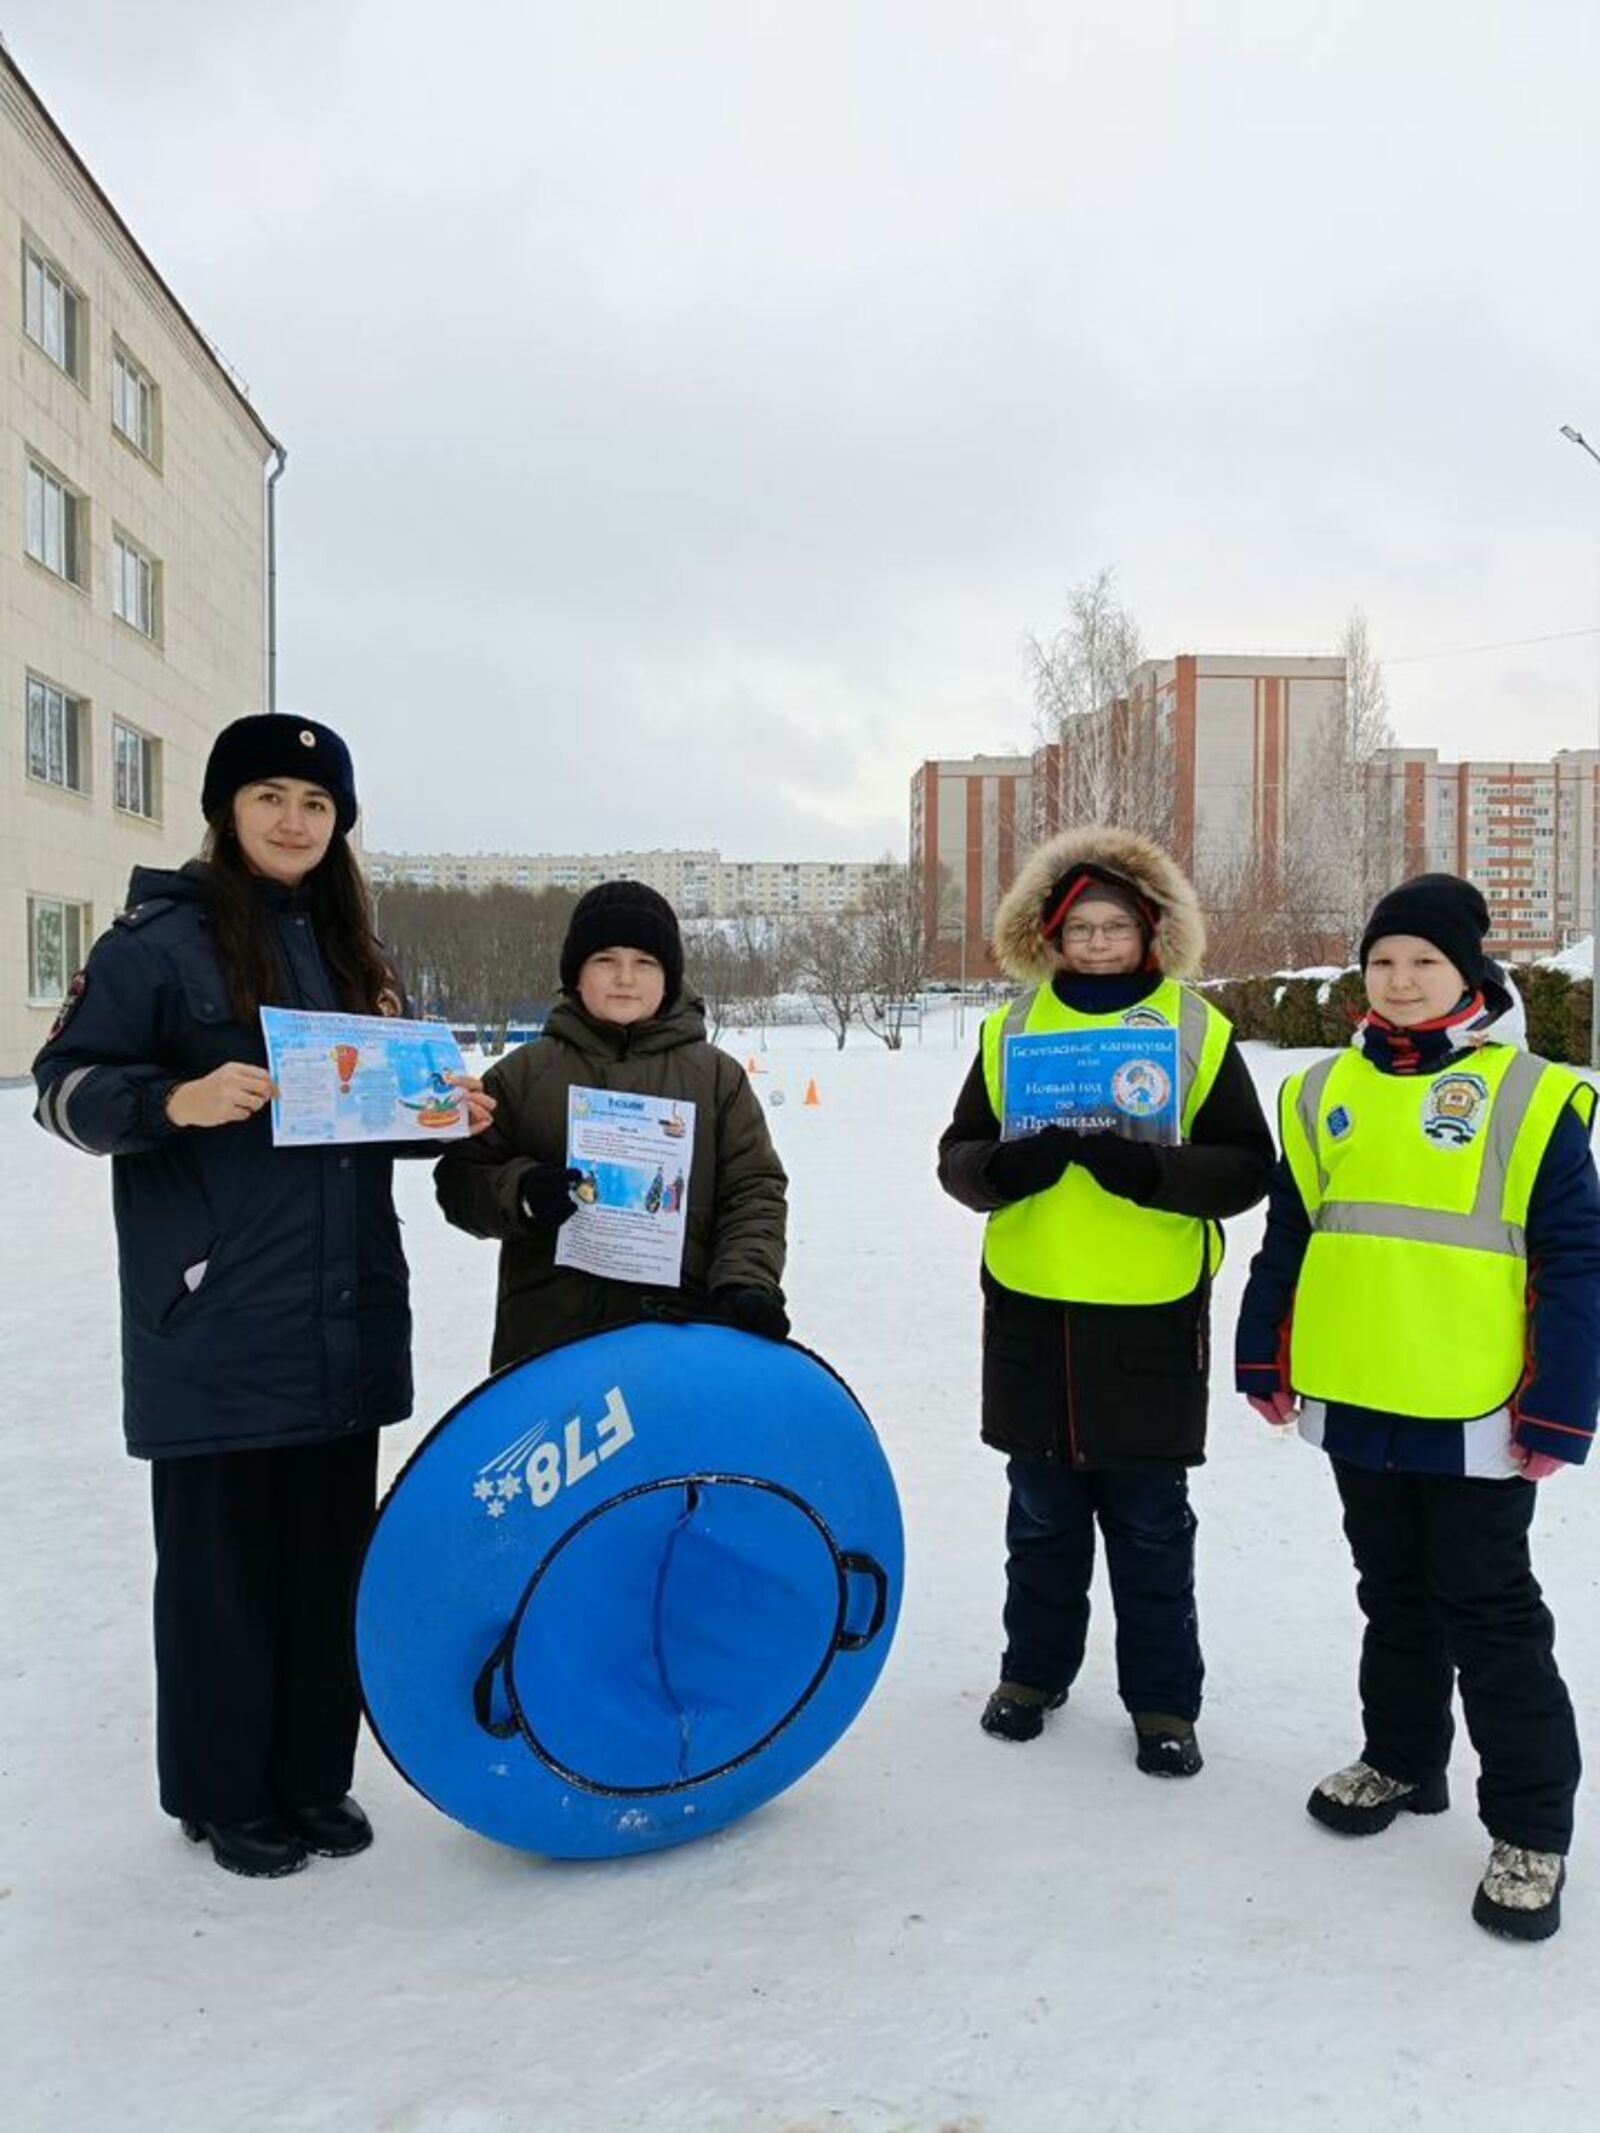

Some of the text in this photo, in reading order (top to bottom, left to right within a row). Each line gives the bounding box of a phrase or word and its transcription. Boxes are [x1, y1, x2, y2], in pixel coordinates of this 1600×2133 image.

[1100, 1041, 1172, 1055] каникулы
[1025, 1081, 1075, 1095] Новый
[526, 1385, 635, 1507] F78
